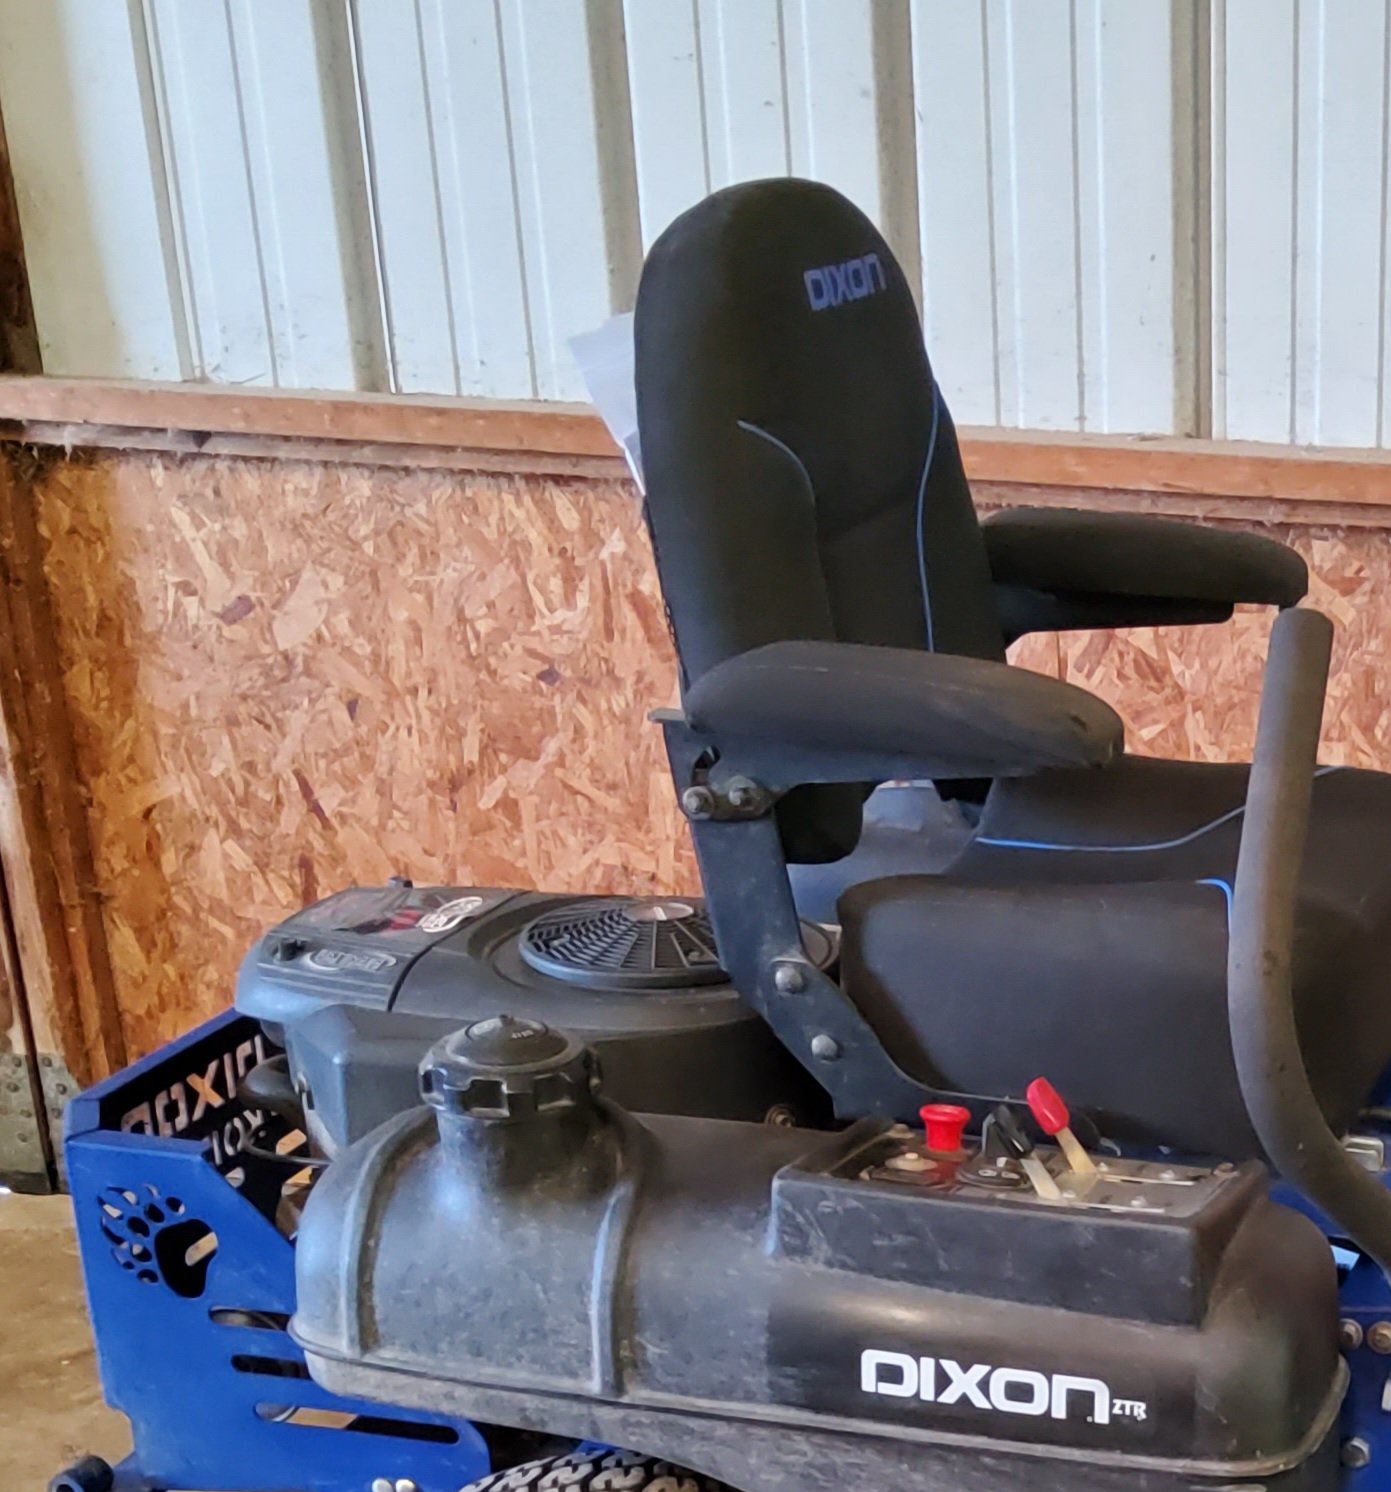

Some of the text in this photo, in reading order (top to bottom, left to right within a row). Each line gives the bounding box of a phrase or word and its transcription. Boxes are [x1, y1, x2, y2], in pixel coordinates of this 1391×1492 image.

[804, 253, 887, 311] DIXON
[860, 1348, 1147, 1425] DIXON ZTR
